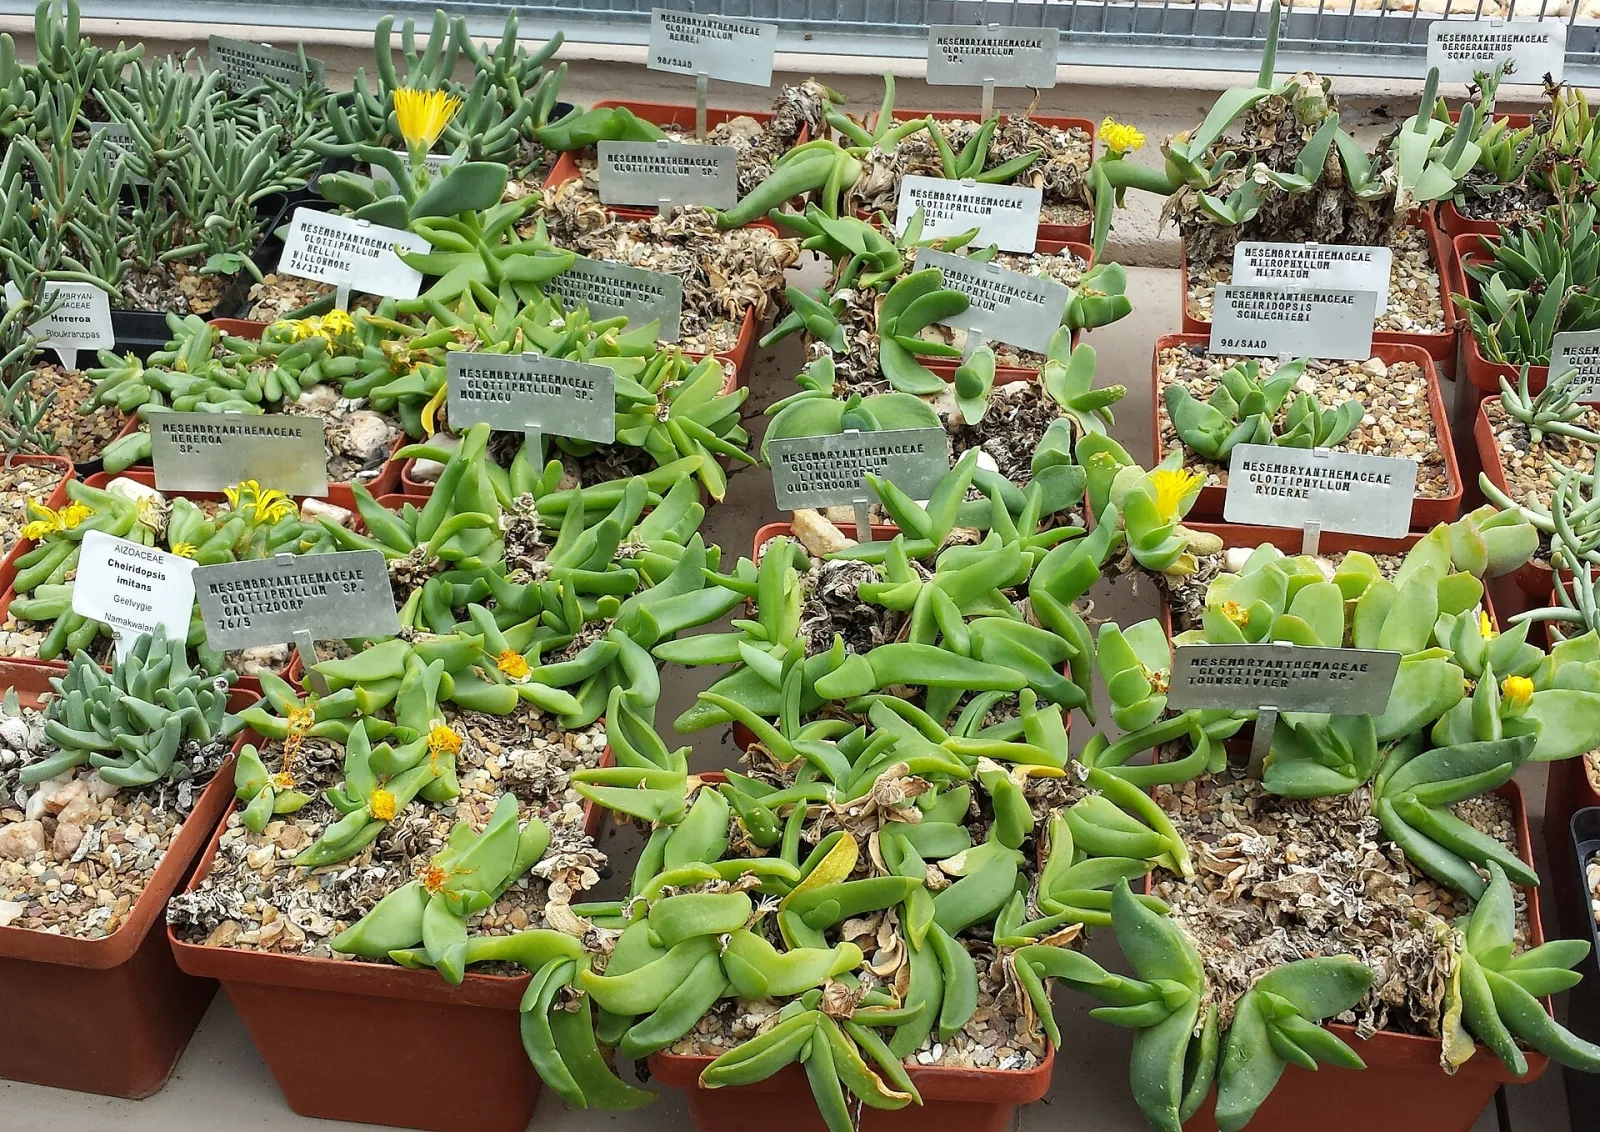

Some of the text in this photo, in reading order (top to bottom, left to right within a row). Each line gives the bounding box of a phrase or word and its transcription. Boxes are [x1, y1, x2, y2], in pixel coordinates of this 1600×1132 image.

[661, 14, 760, 36] MESEMBRYANTHEMACEAE
[665, 24, 733, 40] GLOTTIPHYLLUM
[669, 33, 700, 44] HERREI
[937, 38, 1042, 48] MESEMBRYANTHEMACEAE
[1437, 34, 1548, 43] MESEMBRYANTHEMACEAE
[942, 47, 1014, 55] GLOTTIPHYLLUM
[1442, 43, 1513, 51] BERGERANTHUS
[217, 46, 304, 74] MESEMBRYANTHEMACE
[657, 56, 692, 69] 98/SAAD
[947, 55, 963, 63] SP.
[1447, 52, 1494, 60] SCAPIGER
[608, 154, 718, 166] MESEMBRYANTHEMACEAE
[614, 165, 718, 177] GLOTTIPHYLLUM SP.
[910, 189, 1023, 209] MESEMBRYANTHEMACEAE
[915, 200, 992, 215] GLOTTIPHYLLUM
[924, 210, 954, 220] UIRII
[300, 222, 412, 253] MESEMBRYANTHEMAC
[304, 234, 380, 258] GLOTTIPHYLLUM
[293, 250, 350, 271] WILLOWMORE
[1245, 248, 1371, 262] MESEMBRYANTHEMACEAE
[1250, 259, 1331, 270] MITROPHYLLUM
[1256, 268, 1309, 279] MITRATUM
[551, 276, 632, 298] GLOTTIPHYLLUM
[558, 269, 663, 296] EMBRYANTHEMACEAE
[924, 262, 1046, 304] MEMBRYANTHEMACEAE
[942, 278, 1011, 305] OTTIPHYLLUM
[1225, 290, 1355, 304] MESEMBRYANTHEMACEAE
[1231, 300, 1312, 312] CHEIRIDOPSIS
[50, 314, 91, 323] Hereroa
[1236, 310, 1310, 322] SCHLECHTERI
[46, 329, 101, 340] Bloukranzpas
[1220, 338, 1267, 349] 98/SAAD
[1563, 346, 1600, 356] MESEM
[459, 368, 595, 390] MESEMBRYANTHEMACEAE
[460, 390, 511, 402] MONTAGU
[468, 380, 593, 402] GLOTTIPHYLLUM SP.
[162, 423, 302, 438] MESEMBRYANTHEMACEAE
[171, 434, 222, 444] HEREROA
[179, 444, 200, 454] SP.
[782, 443, 925, 463] MESEMBRYANTHEMACEAE
[791, 457, 888, 472] GLOTTIPHYLLUM
[1243, 461, 1392, 485] MESEMBRYANTHEMACEAE
[787, 480, 860, 493] OUDTSHOORN
[1249, 473, 1351, 492] GLOTTIPHYLLUM
[1255, 485, 1310, 499] RYDERAE
[114, 544, 165, 565] AIZOACEAE
[107, 558, 166, 581] Cheiridopsis
[116, 575, 152, 592] imitans
[209, 570, 365, 594] MESEMBRYANTHEMACEAE
[221, 582, 365, 605] GLOTTIPHYLLUM SP.
[113, 594, 153, 612] Geelvygie
[224, 599, 304, 617] CALITZDORP
[104, 612, 156, 633] Namakwalan
[218, 617, 251, 631] 76/5
[1190, 658, 1369, 672] MESEMBRYANTHEMACEAE
[1199, 667, 1354, 681] GLOTTIPHYLLUM SP.
